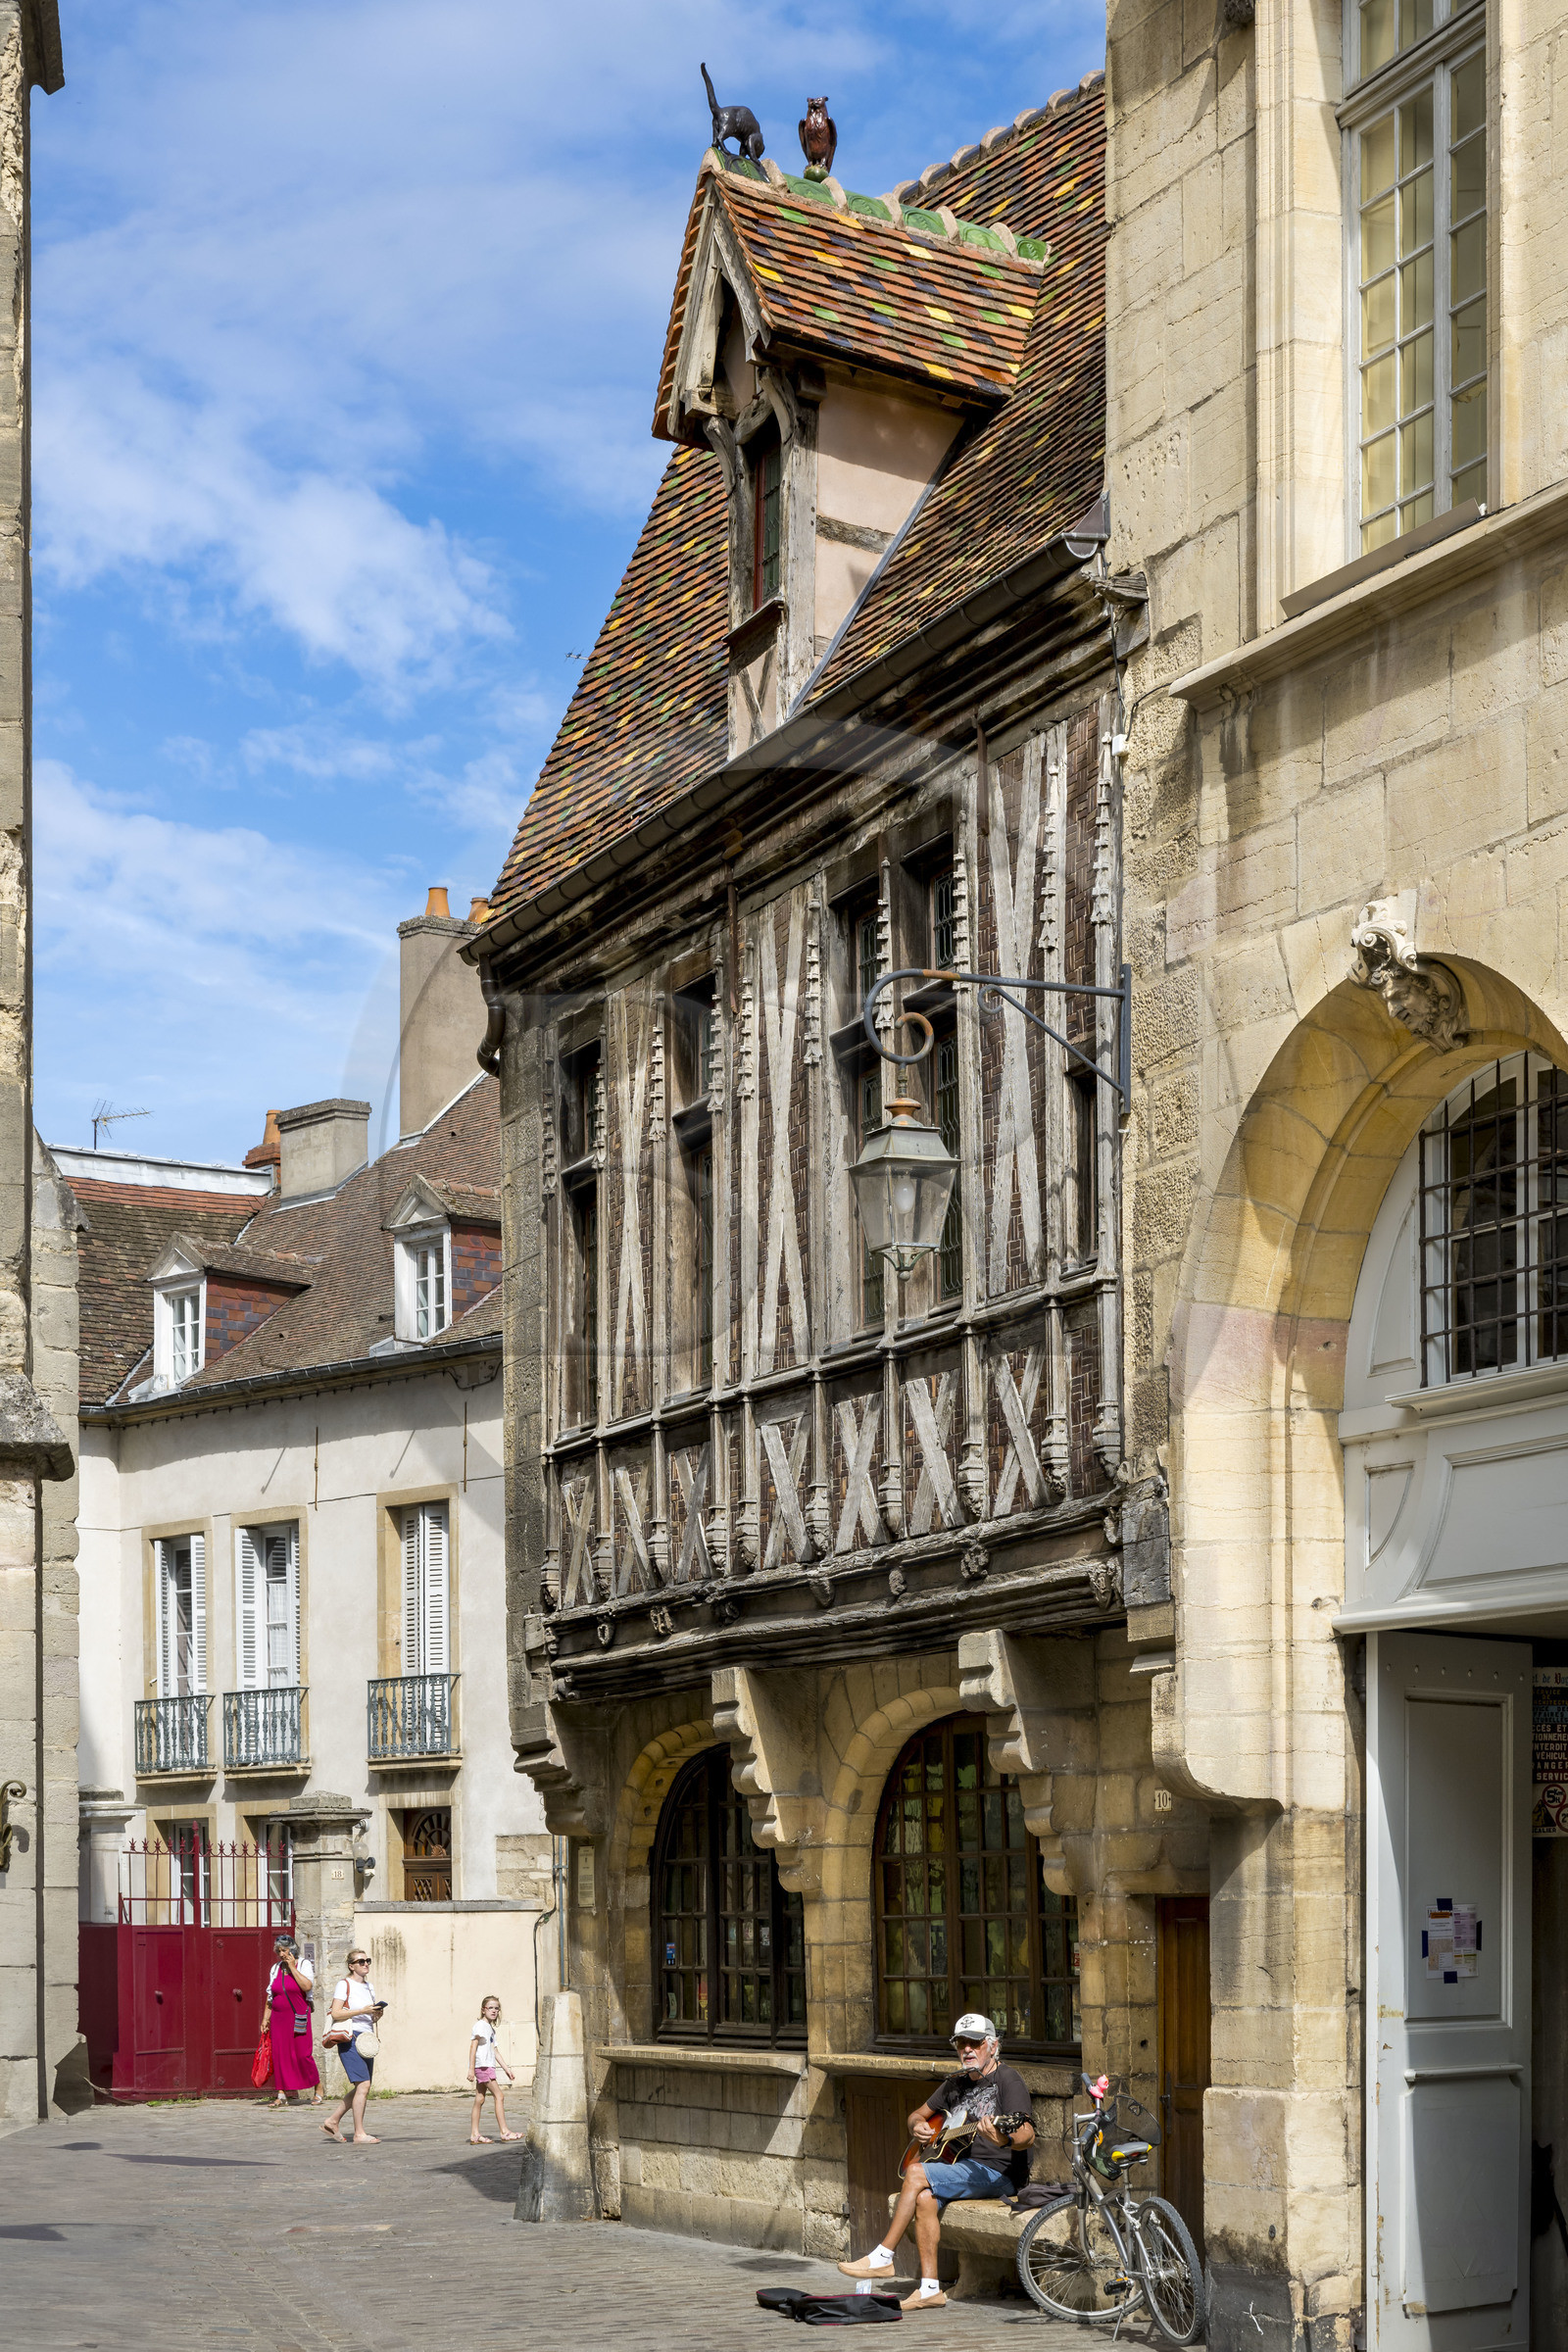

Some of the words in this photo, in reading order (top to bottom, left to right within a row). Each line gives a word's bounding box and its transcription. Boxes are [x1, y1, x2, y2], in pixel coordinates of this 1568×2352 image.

[1556, 1724, 1567, 1733] ET
[1157, 1791, 1167, 1807] 10
[1546, 1790, 1556, 1803] 5
